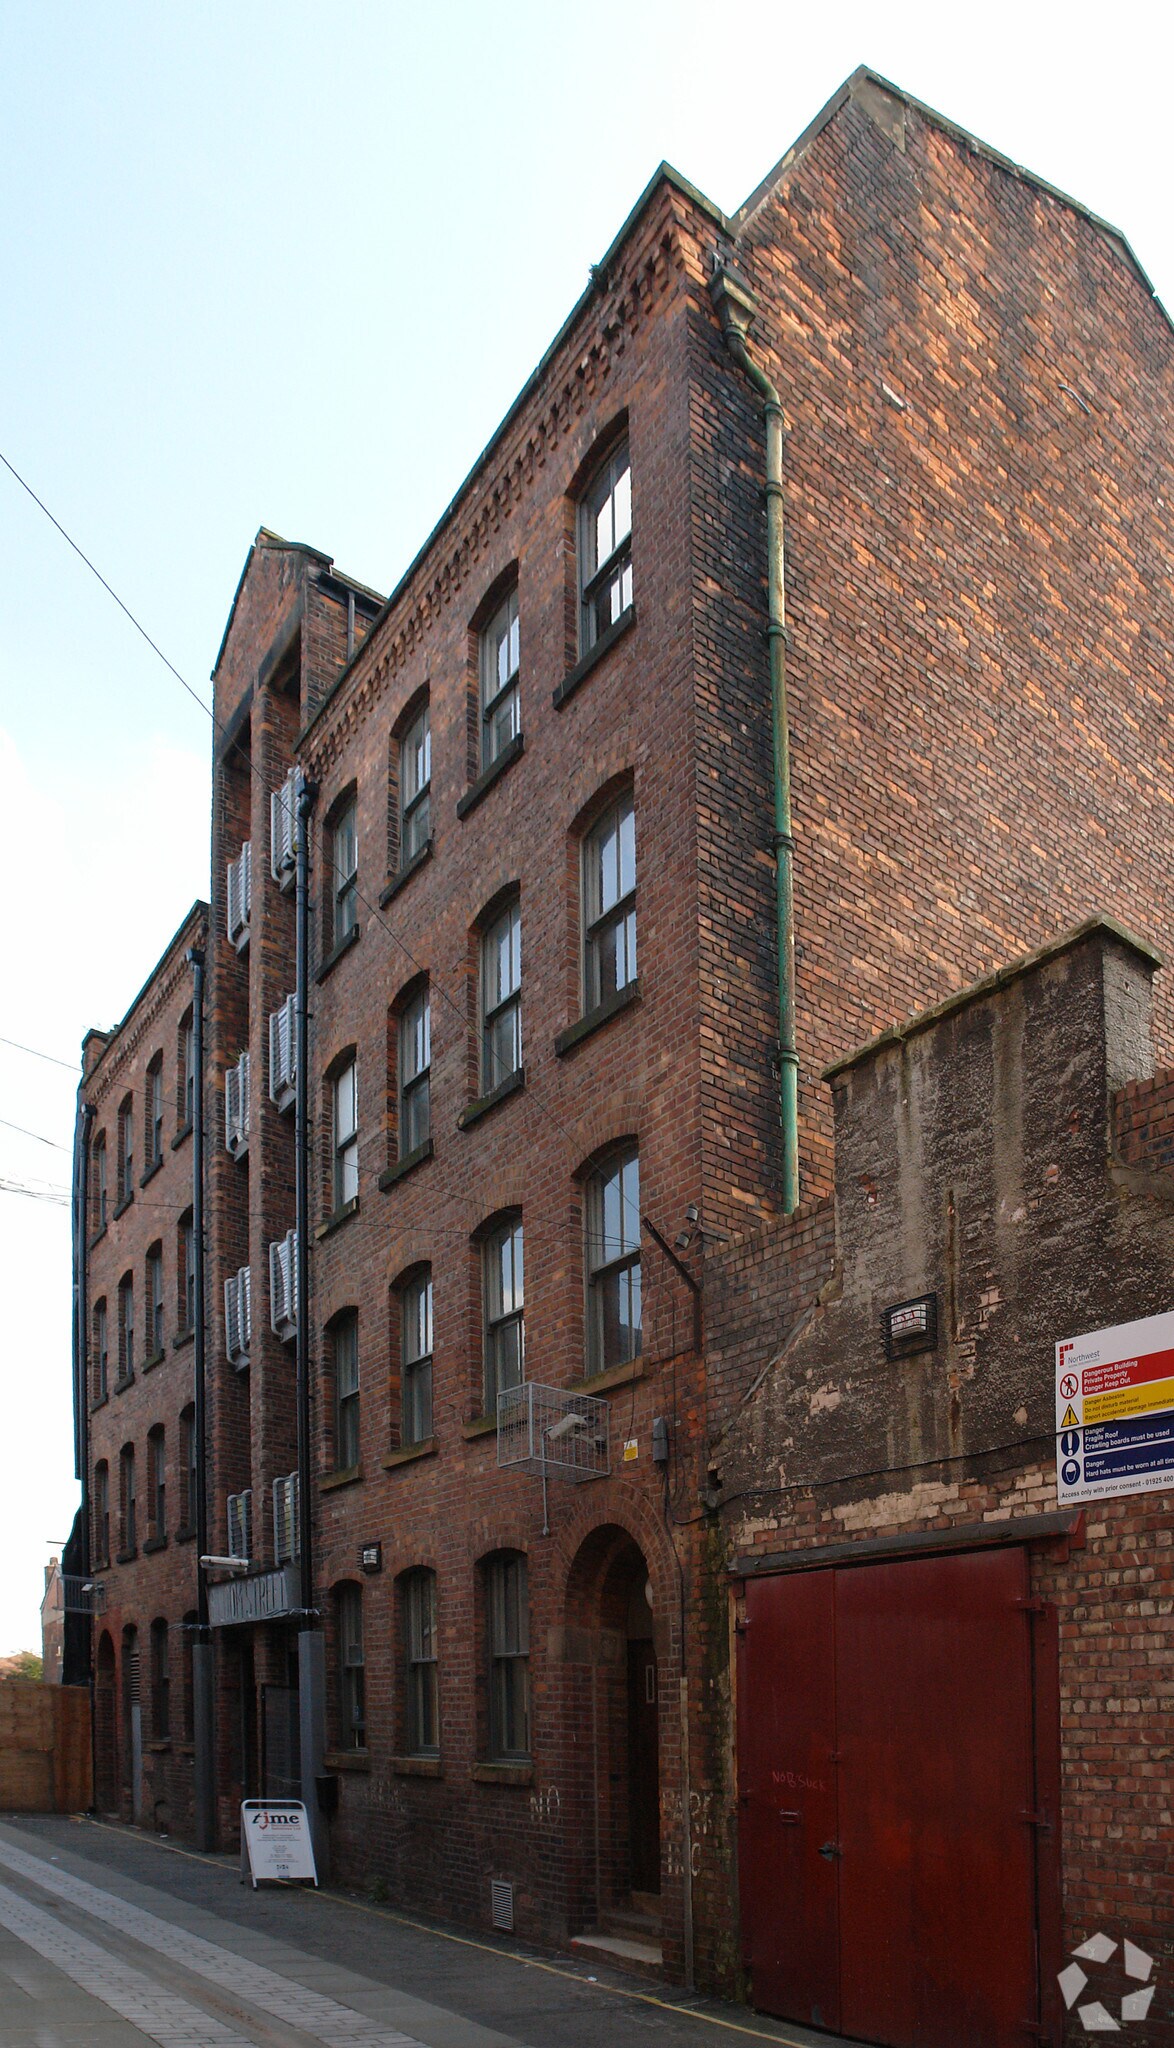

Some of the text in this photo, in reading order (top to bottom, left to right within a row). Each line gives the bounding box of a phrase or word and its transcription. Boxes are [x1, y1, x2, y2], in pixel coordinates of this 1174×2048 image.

[1068, 1350, 1100, 1364] Northwest
[1084, 1361, 1138, 1378] Dangerous Building
[1084, 1370, 1128, 1385] Private Property
[1084, 1376, 1131, 1393] Danger Keep Out
[1084, 1396, 1102, 1406] Danger
[1101, 1402, 1118, 1411] disturb
[1119, 1397, 1139, 1406] material
[1085, 1412, 1101, 1421] Report
[1102, 1407, 1126, 1417] accidental
[1127, 1403, 1146, 1413] damage
[1085, 1427, 1105, 1436] Danger
[1085, 1431, 1119, 1443] Fragile Roof
[1085, 1441, 1109, 1451] Crawling
[1110, 1436, 1130, 1446] boards
[1131, 1433, 1146, 1442] must
[1155, 1429, 1170, 1437] used
[1086, 1460, 1105, 1469] Danger
[1086, 1469, 1099, 1477] Hard
[1112, 1465, 1126, 1473] must
[1135, 1461, 1149, 1469] worn
[1061, 1491, 1080, 1499] Access
[1081, 1488, 1092, 1497] only
[1093, 1486, 1104, 1494] with
[1105, 1483, 1118, 1492] prior
[1119, 1481, 1141, 1490] consent
[1145, 1477, 1163, 1486] 01925
[252, 1812, 300, 1825] time
